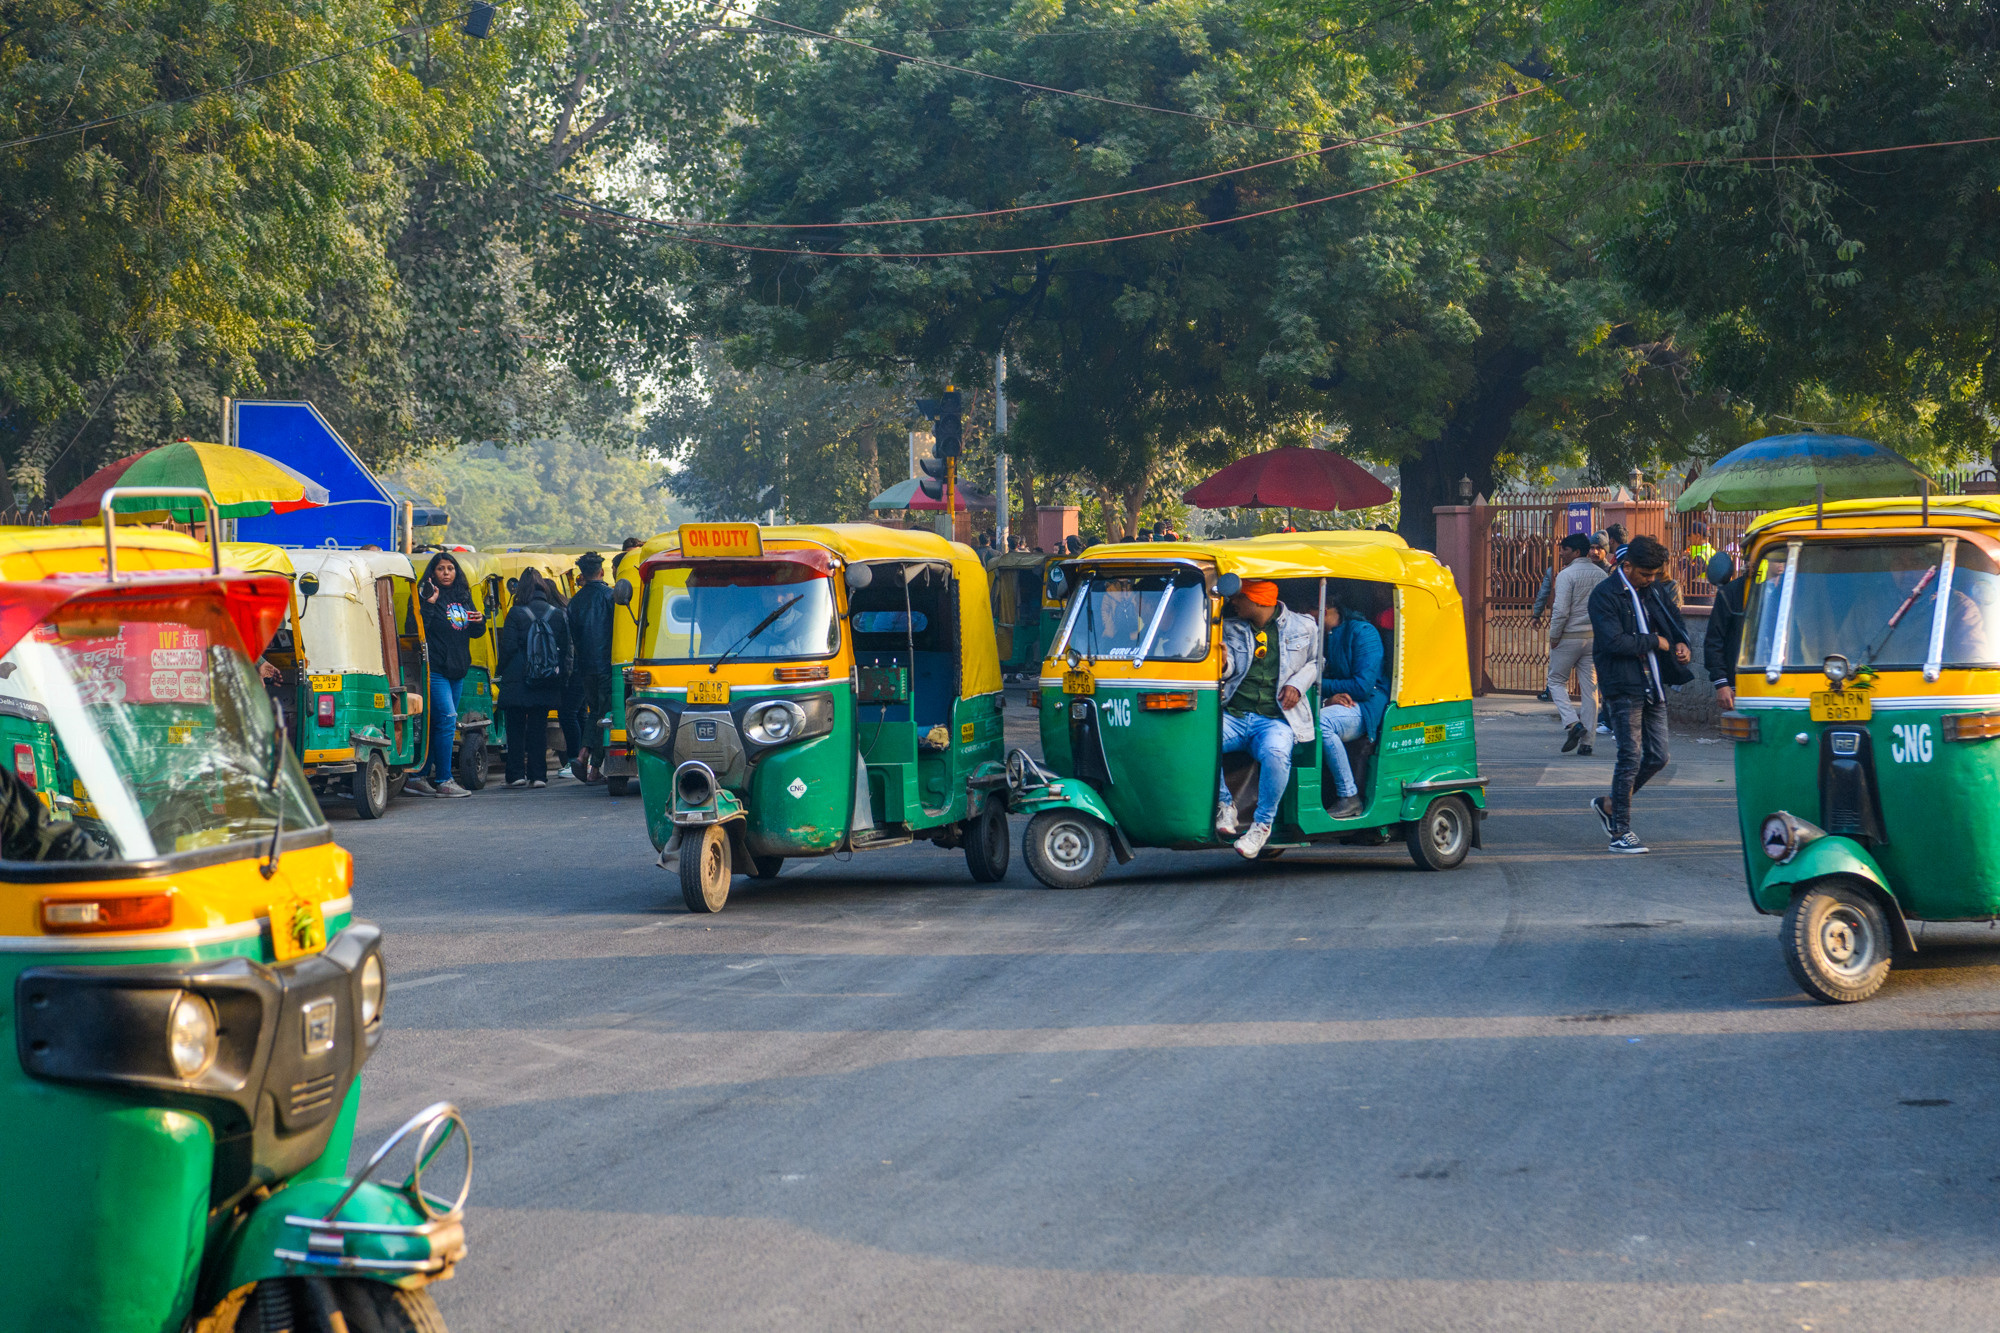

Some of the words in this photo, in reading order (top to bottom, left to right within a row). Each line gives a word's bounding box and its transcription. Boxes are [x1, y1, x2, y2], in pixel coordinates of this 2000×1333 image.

[688, 530, 709, 547] ON
[712, 530, 748, 547] DUTY
[159, 631, 179, 649] IVF
[1109, 647, 1131, 655] GURU
[1107, 698, 1131, 727] CNG
[1826, 707, 1859, 719] 6051
[698, 727, 714, 737] RE
[1891, 723, 1933, 763] CNG
[789, 784, 805, 792] CNG
